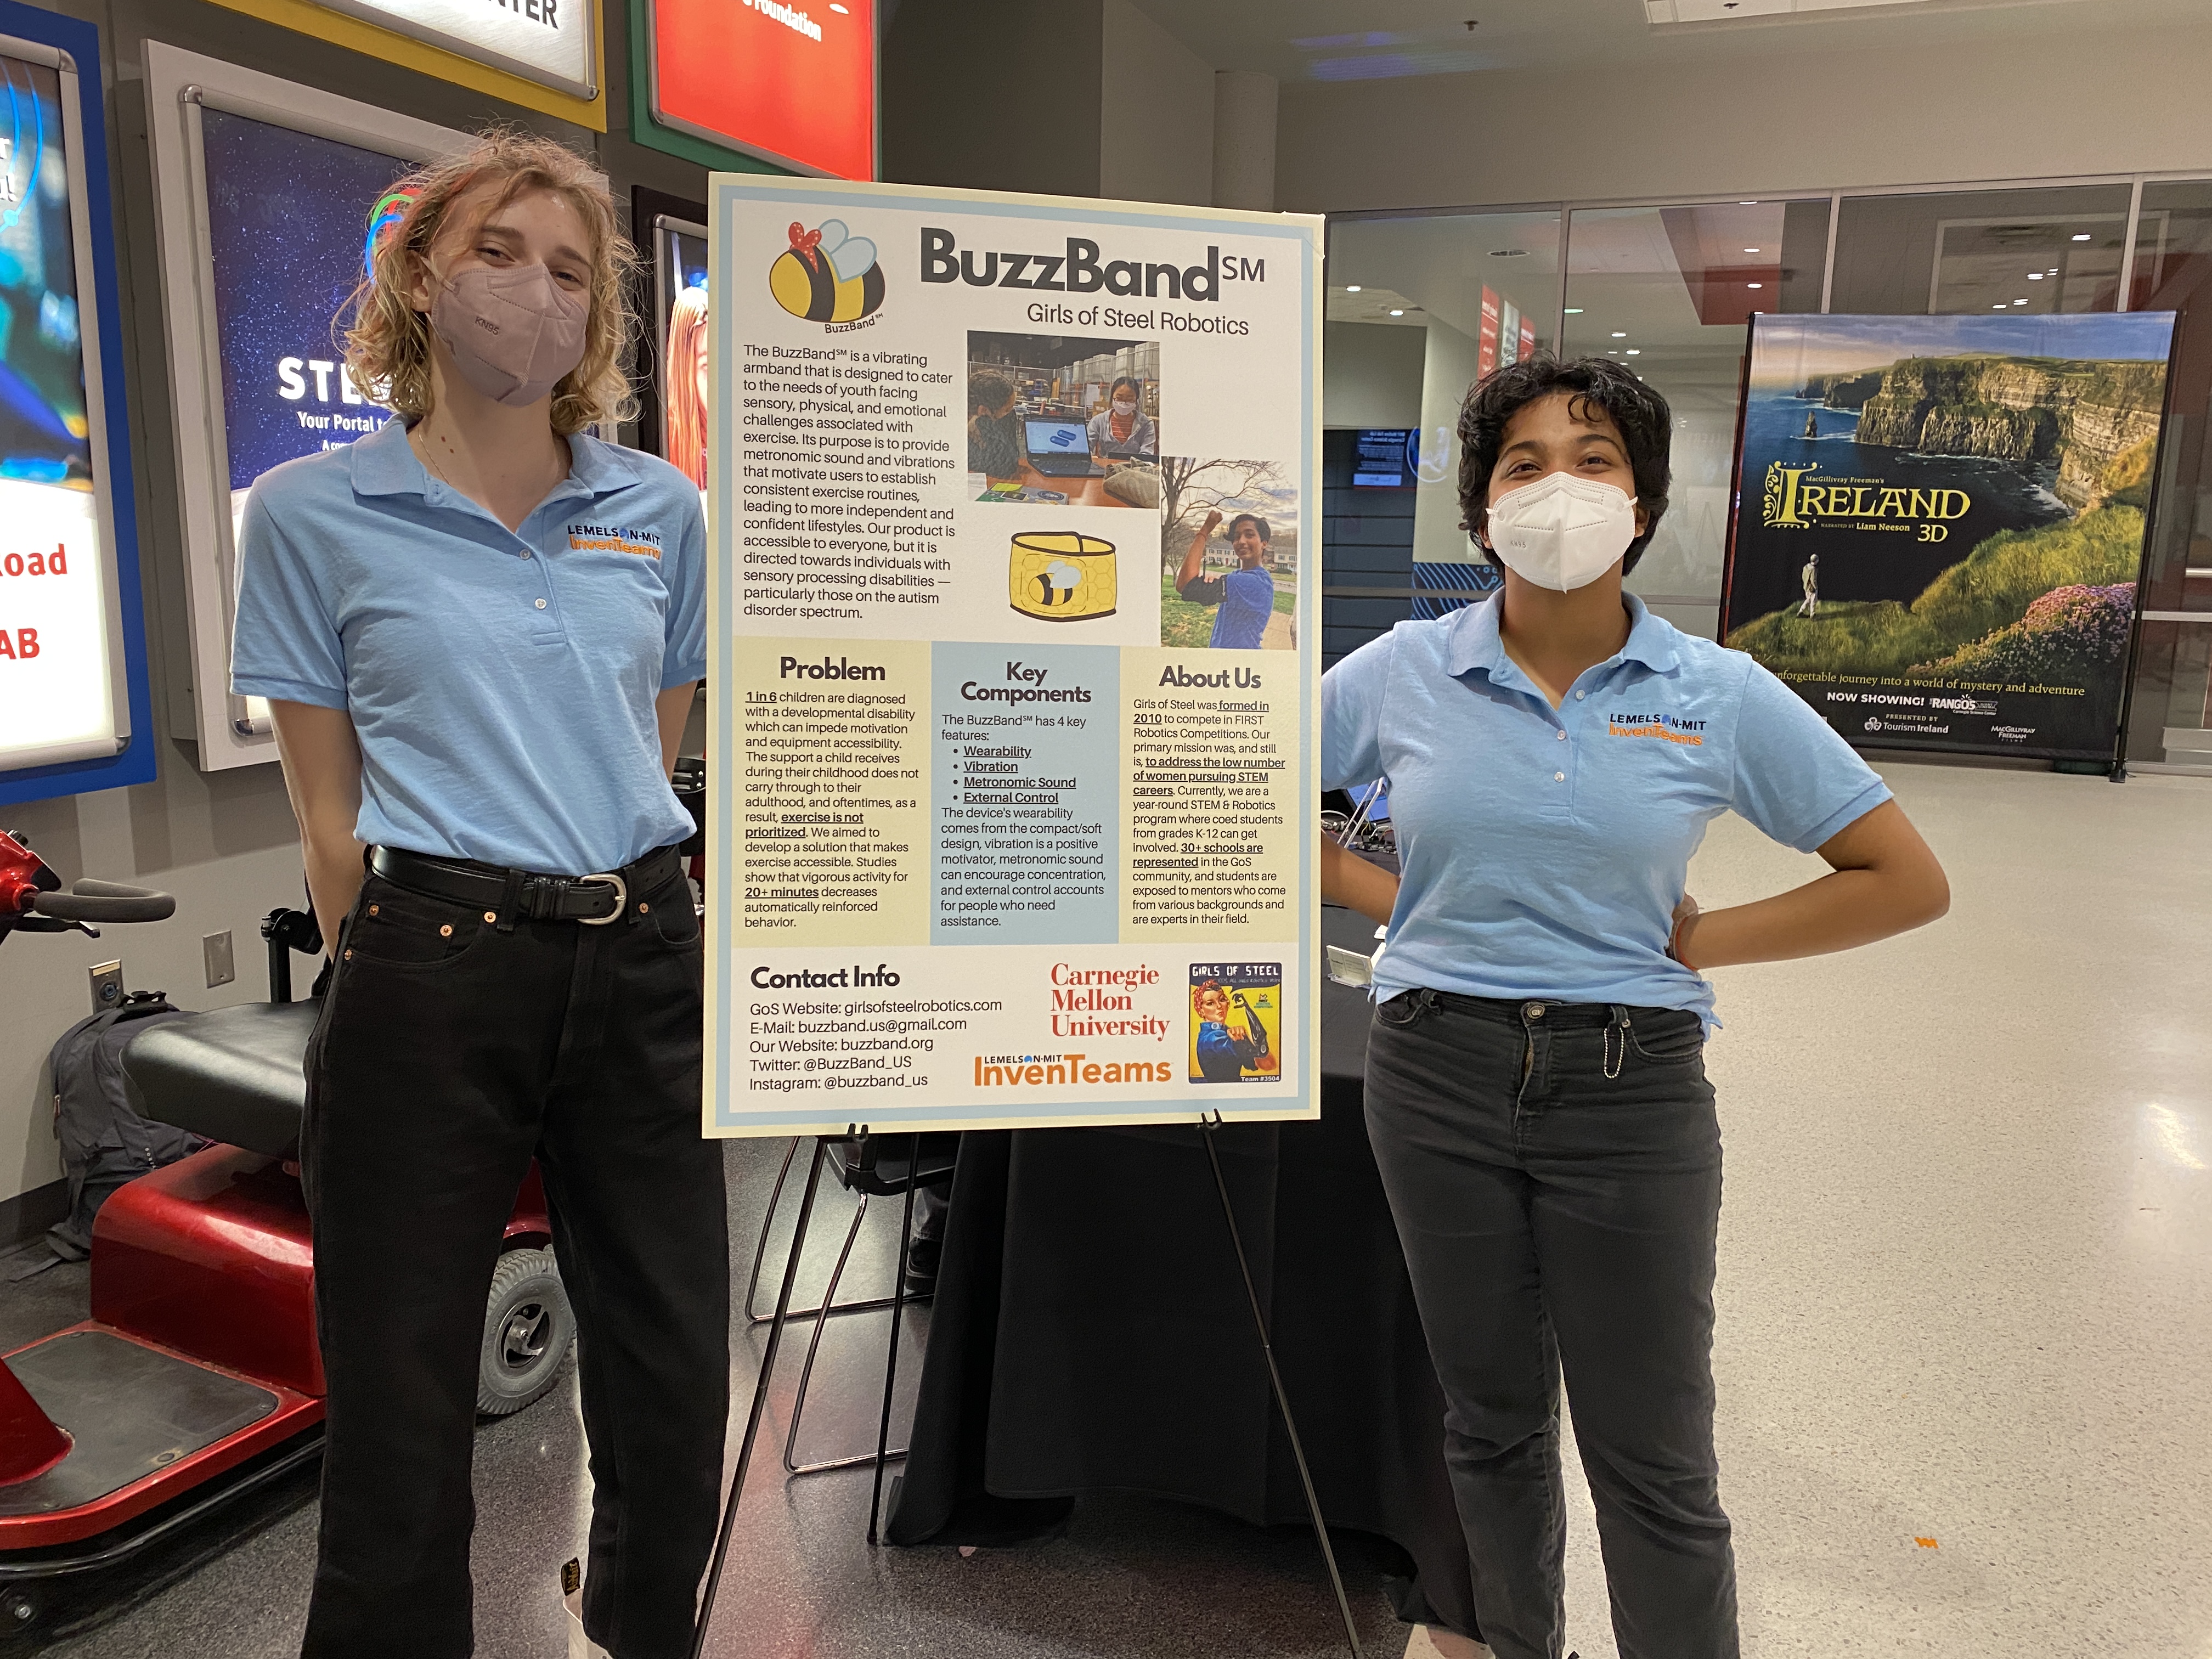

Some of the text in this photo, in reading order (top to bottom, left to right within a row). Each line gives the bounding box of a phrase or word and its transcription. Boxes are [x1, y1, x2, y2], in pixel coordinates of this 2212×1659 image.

[475, 317, 499, 335] KN95
[1028, 303, 1249, 335] Girls of Steel Robotics
[744, 345, 769, 357] The
[851, 350, 860, 362] is
[862, 353, 869, 362] a
[873, 352, 927, 368] vibrating
[744, 363, 952, 383] armband that is designed to cater
[743, 380, 917, 402] to the needs of youth facing
[743, 399, 946, 417] sensory, physical, and emotional
[297, 411, 330, 429] Your
[334, 414, 374, 432] Portal
[1805, 476, 1848, 484] MacGillivray
[1763, 461, 1971, 529] IRELAND
[1918, 524, 1948, 543] 3D
[0, 543, 67, 576] oad
[781, 657, 885, 680] Problem
[1007, 662, 1048, 686] Key
[1159, 665, 1261, 689] About Us
[961, 681, 1091, 707] Components
[1839, 674, 1877, 686] journey
[1881, 676, 1901, 685] into
[1912, 678, 1943, 688] world
[1946, 679, 1959, 689] of
[1960, 682, 2002, 693] mystery
[2006, 682, 2025, 692] and
[2029, 684, 2085, 696] adventure
[745, 691, 753, 703] 1
[755, 691, 767, 703] in
[769, 691, 777, 703] 6
[780, 692, 825, 702] children
[848, 693, 905, 706] diagnosed
[1134, 699, 1155, 709] Girls
[1158, 699, 1168, 709] of
[1171, 700, 1195, 709] Steel
[1218, 701, 1257, 712] formed
[1259, 701, 1269, 713] in
[1827, 692, 1858, 702] NOW
[1861, 693, 1925, 706] SHOWING!
[1932, 697, 1976, 710] RANGOS
[746, 707, 769, 716] with
[781, 707, 865, 719] developmental
[867, 708, 915, 721] disability
[942, 714, 963, 725] The
[1036, 715, 1054, 726] has
[1057, 716, 1064, 726] 4
[1067, 716, 1086, 729] key
[1133, 714, 1264, 726] 2010 to compete in FIRST
[942, 729, 989, 741] features:
[1609, 717, 1702, 746] InvenTeams
[1883, 722, 1949, 733] Tourism Ireland
[963, 746, 1031, 759] Wearability
[963, 761, 1018, 774] Vibration
[963, 777, 1076, 789] Metronomic Sound
[963, 792, 1058, 804] External Control
[751, 964, 900, 989] Contact Info
[1051, 963, 1159, 991] Carnegie
[1227, 966, 1238, 977] OF
[1245, 966, 1279, 976] STEEL
[751, 1000, 1002, 1017] GoS Website: girlsofsteelrobotics.com
[1051, 989, 1132, 1011] Mellon
[751, 1018, 967, 1034] E-Mail: buzzband.us@gmail.com
[1051, 1015, 1170, 1041] University
[750, 1037, 933, 1053] Our Website: buzzband.org
[749, 1056, 911, 1071] Twitter: @BuzzBand_US
[975, 1054, 1172, 1086] InvenTeams
[751, 1074, 928, 1092] Instagram: @buzzband_us
